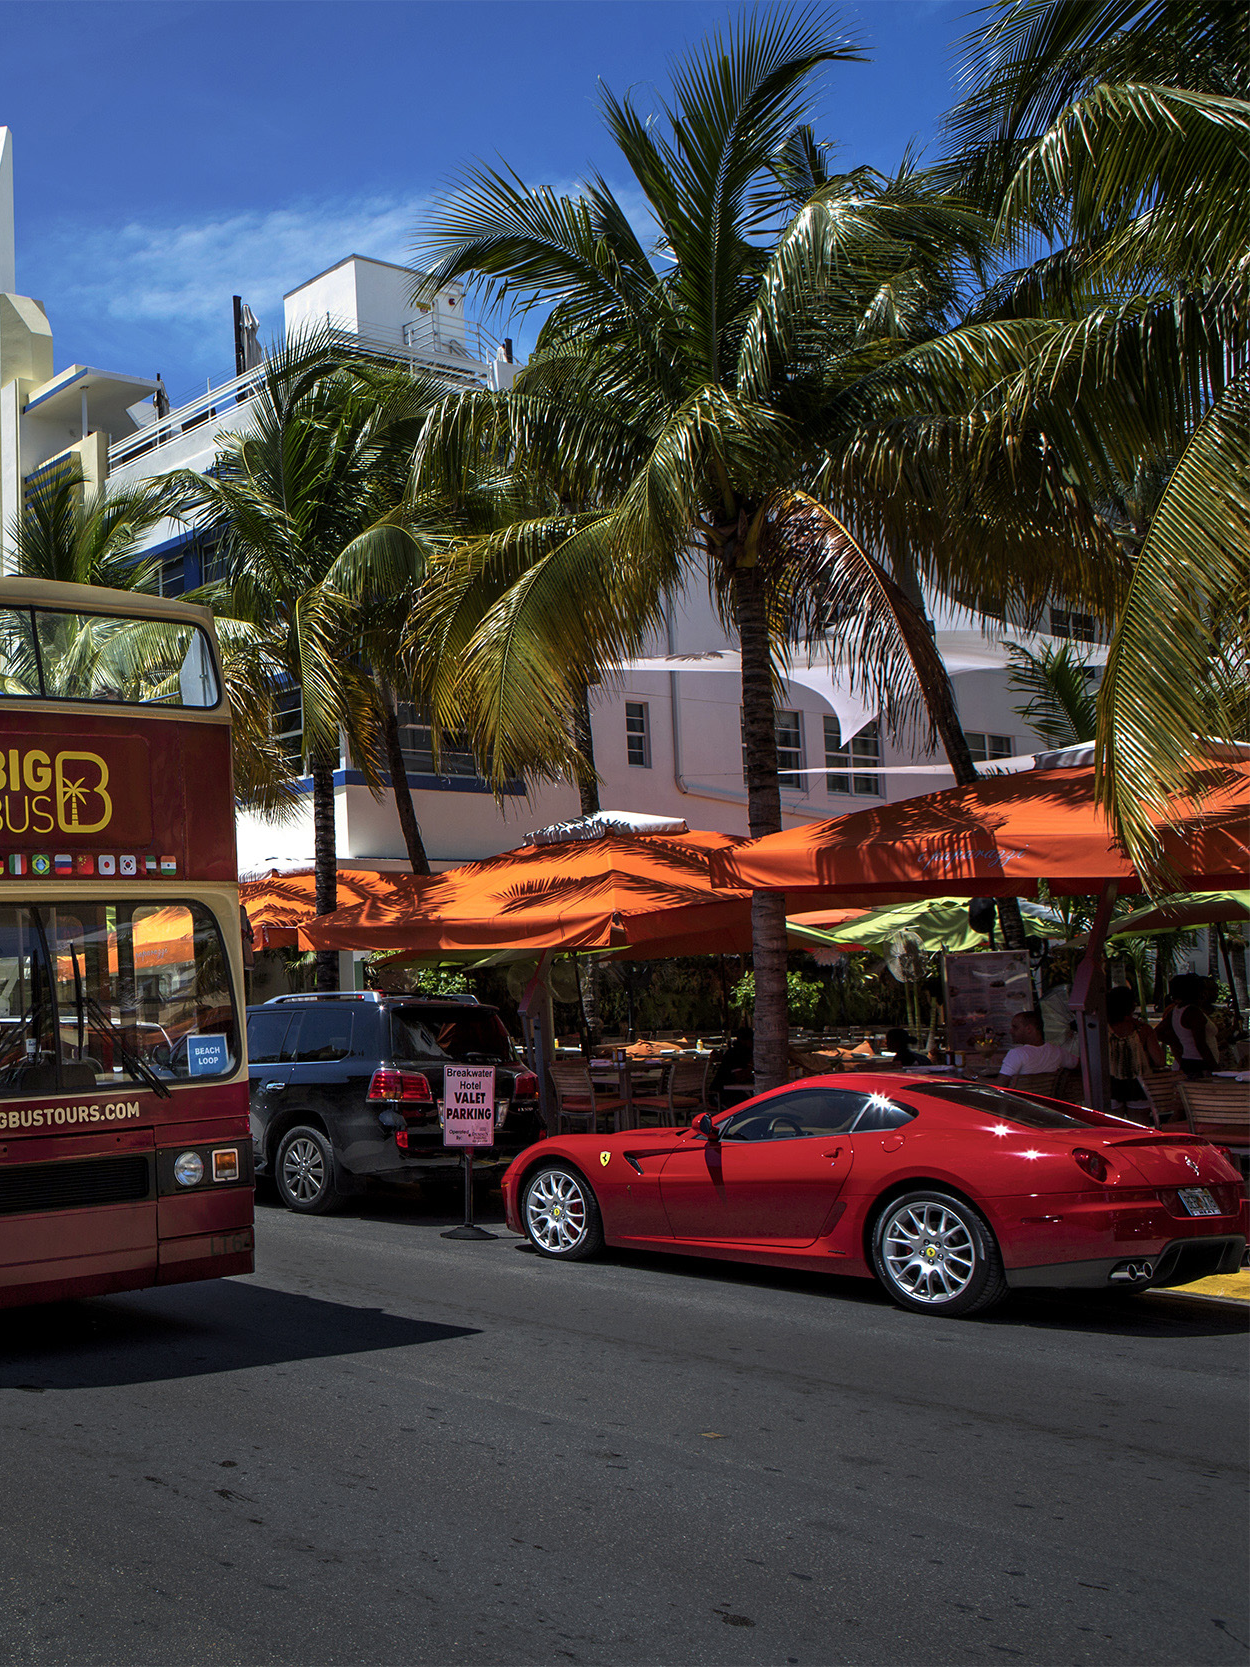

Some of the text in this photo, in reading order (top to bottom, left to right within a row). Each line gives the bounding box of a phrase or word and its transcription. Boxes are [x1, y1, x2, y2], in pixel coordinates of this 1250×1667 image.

[923, 844, 1029, 870] paparazzi
[194, 1046, 221, 1056] BEACH
[198, 1056, 219, 1065] LOOP
[447, 1068, 493, 1078] Breakwater
[460, 1081, 481, 1090] Hotel
[454, 1092, 486, 1104] VALET
[446, 1108, 492, 1120] PARKING
